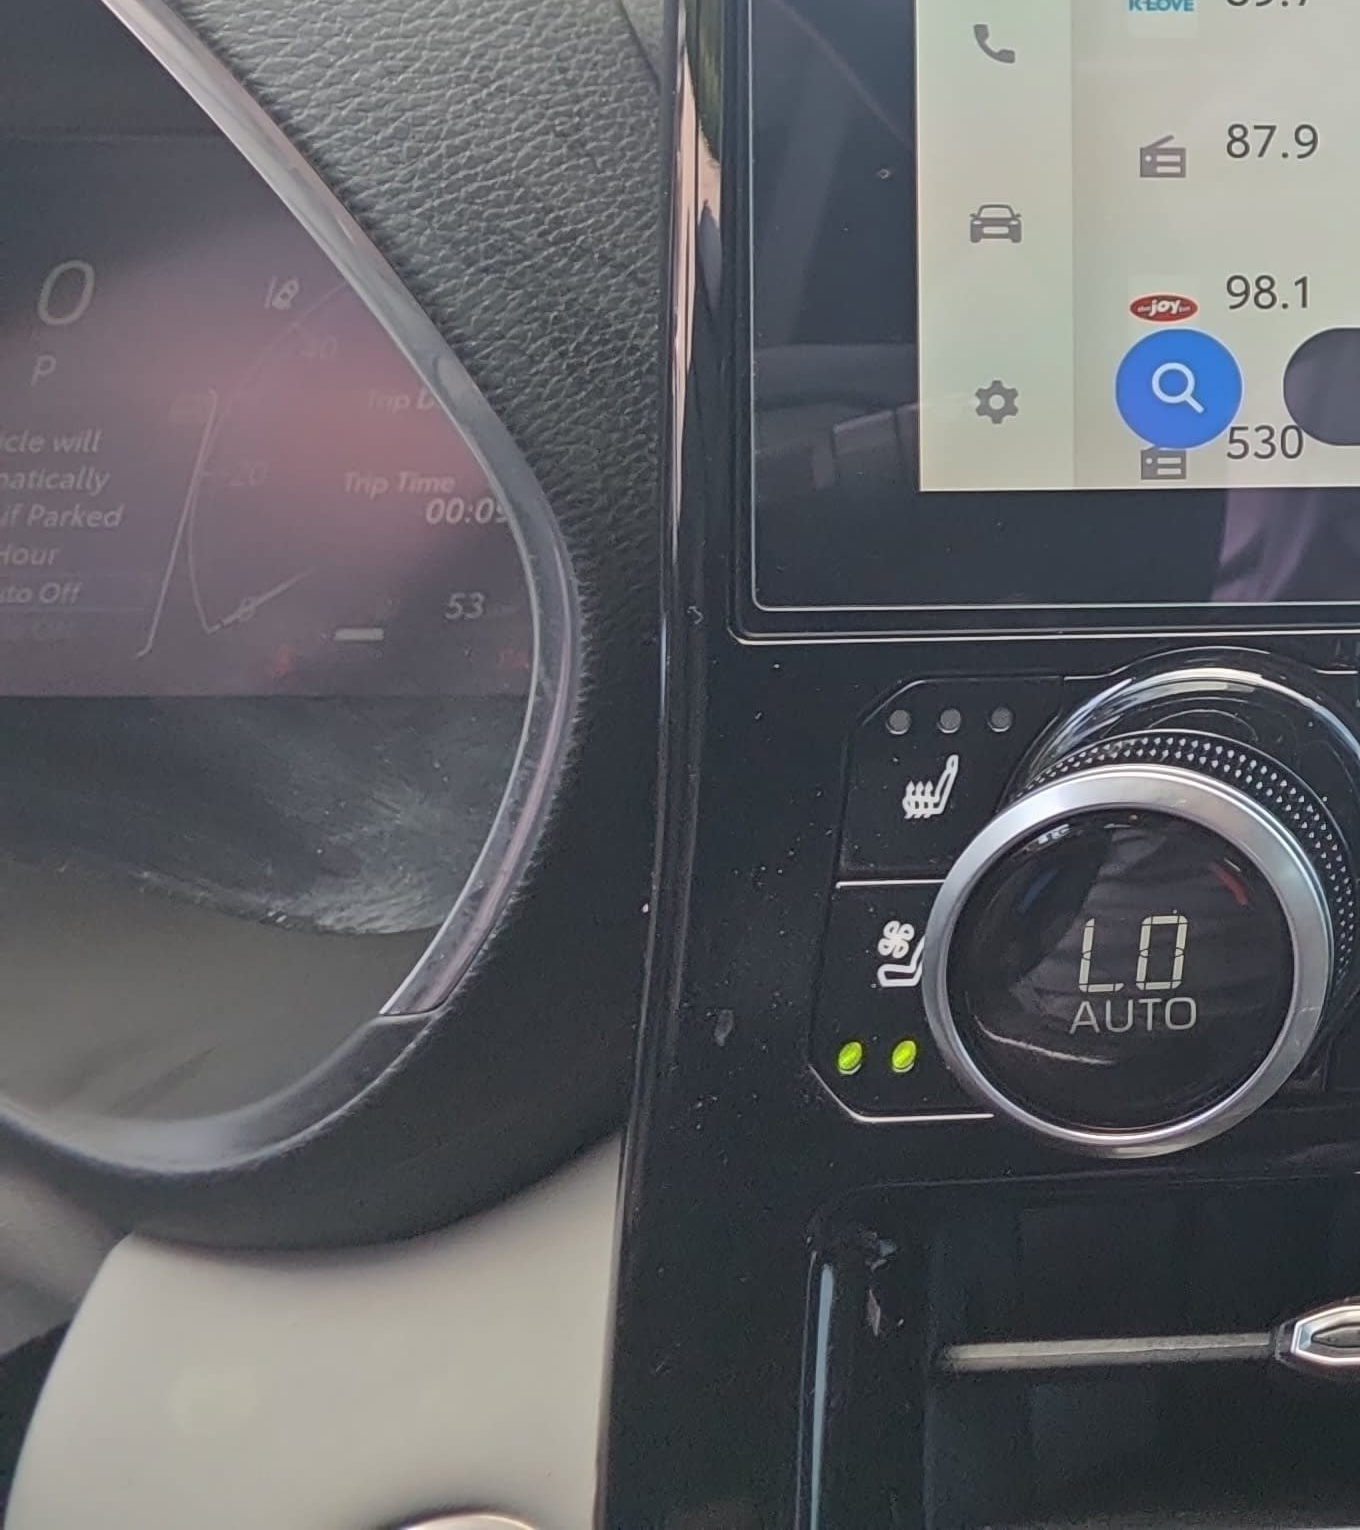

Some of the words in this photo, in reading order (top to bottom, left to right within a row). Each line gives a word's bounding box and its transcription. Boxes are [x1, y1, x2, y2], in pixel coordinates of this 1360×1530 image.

[1225, 123, 1320, 161] 87.9
[1225, 274, 1311, 313] 98.1
[31, 355, 57, 386] P
[53, 428, 102, 453] will
[1226, 424, 1306, 462] 530
[344, 471, 389, 499] Trip
[397, 471, 456, 493] Time
[27, 502, 125, 528] Parked
[39, 582, 83, 604] Off
[444, 591, 486, 620] 53
[1080, 914, 1189, 993] LO
[1069, 997, 1197, 1034] AUTO
